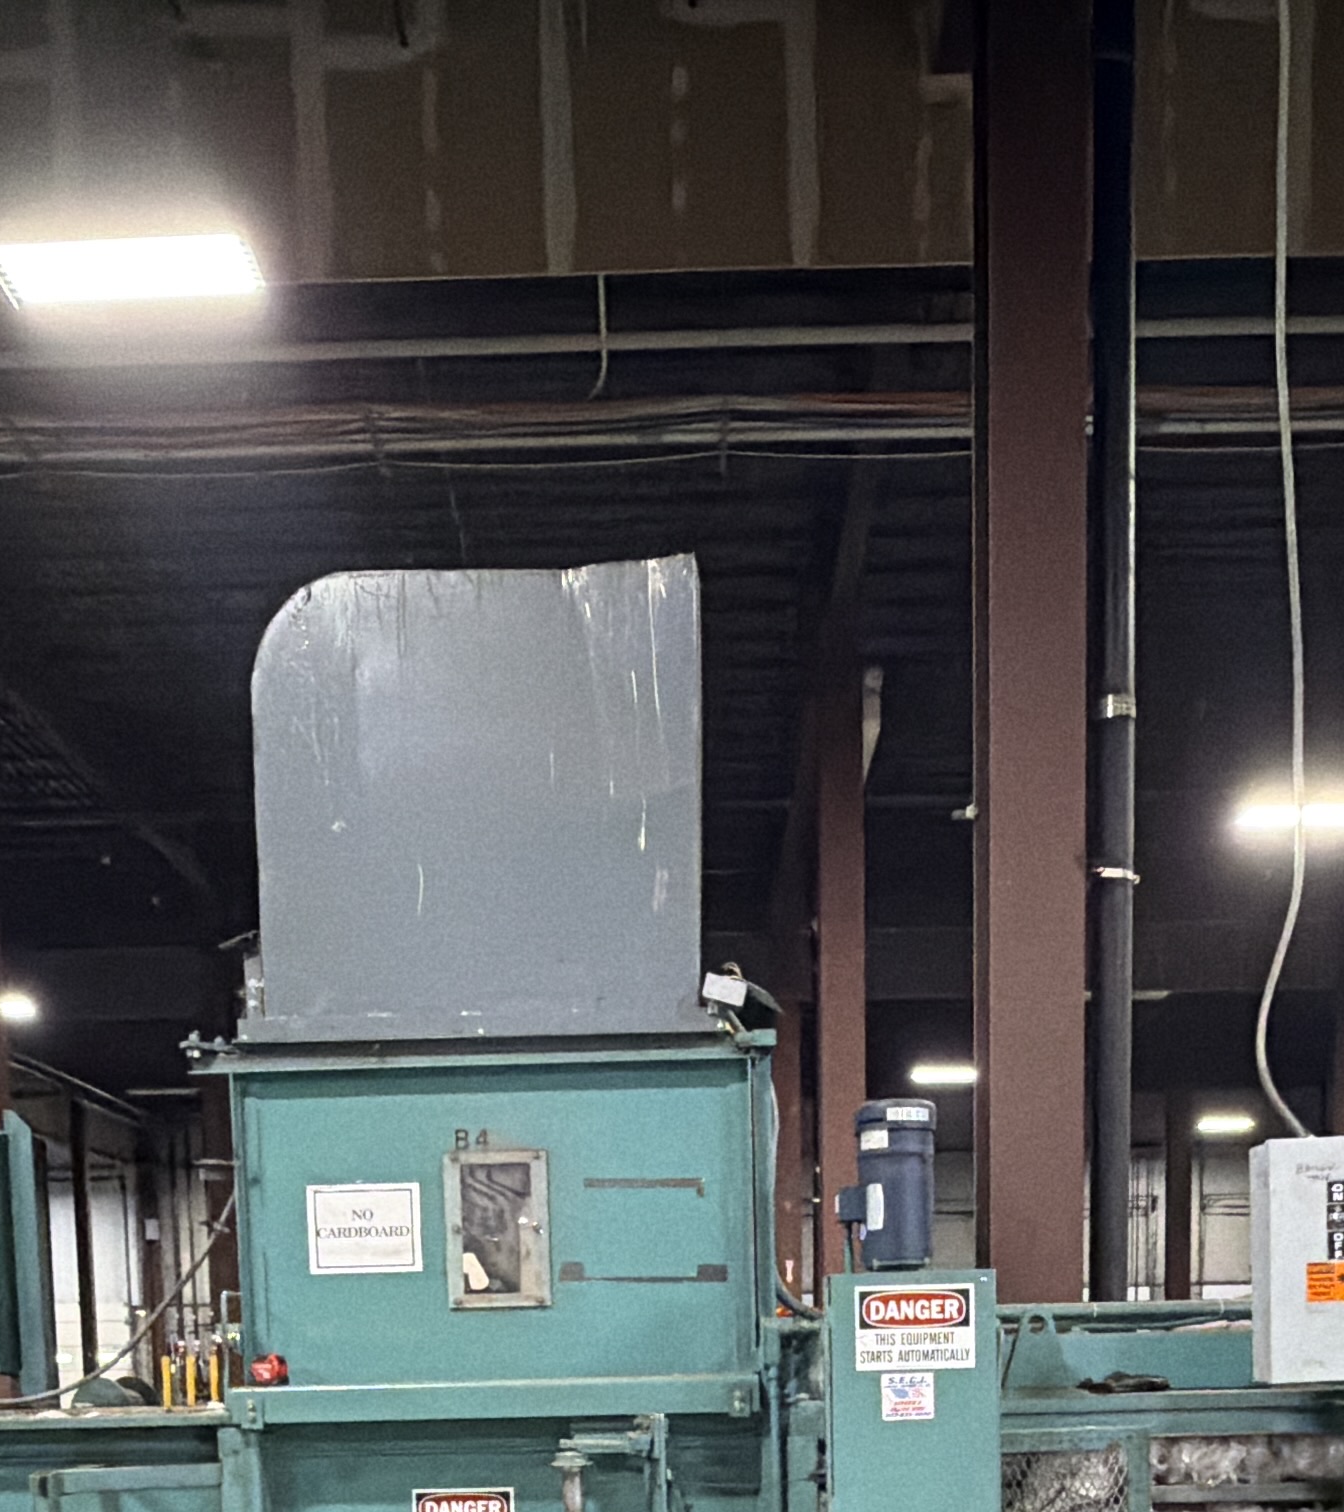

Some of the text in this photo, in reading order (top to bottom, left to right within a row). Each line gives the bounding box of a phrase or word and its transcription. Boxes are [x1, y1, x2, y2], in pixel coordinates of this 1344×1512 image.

[1331, 1184, 1344, 1201] ON
[351, 1209, 374, 1221] NO
[317, 1226, 410, 1239] CARDBOARD
[869, 1299, 960, 1321] DANGER
[875, 1332, 955, 1346] THIS EQUIPMENT
[859, 1348, 970, 1364] STARTS AUTOMATICALLY
